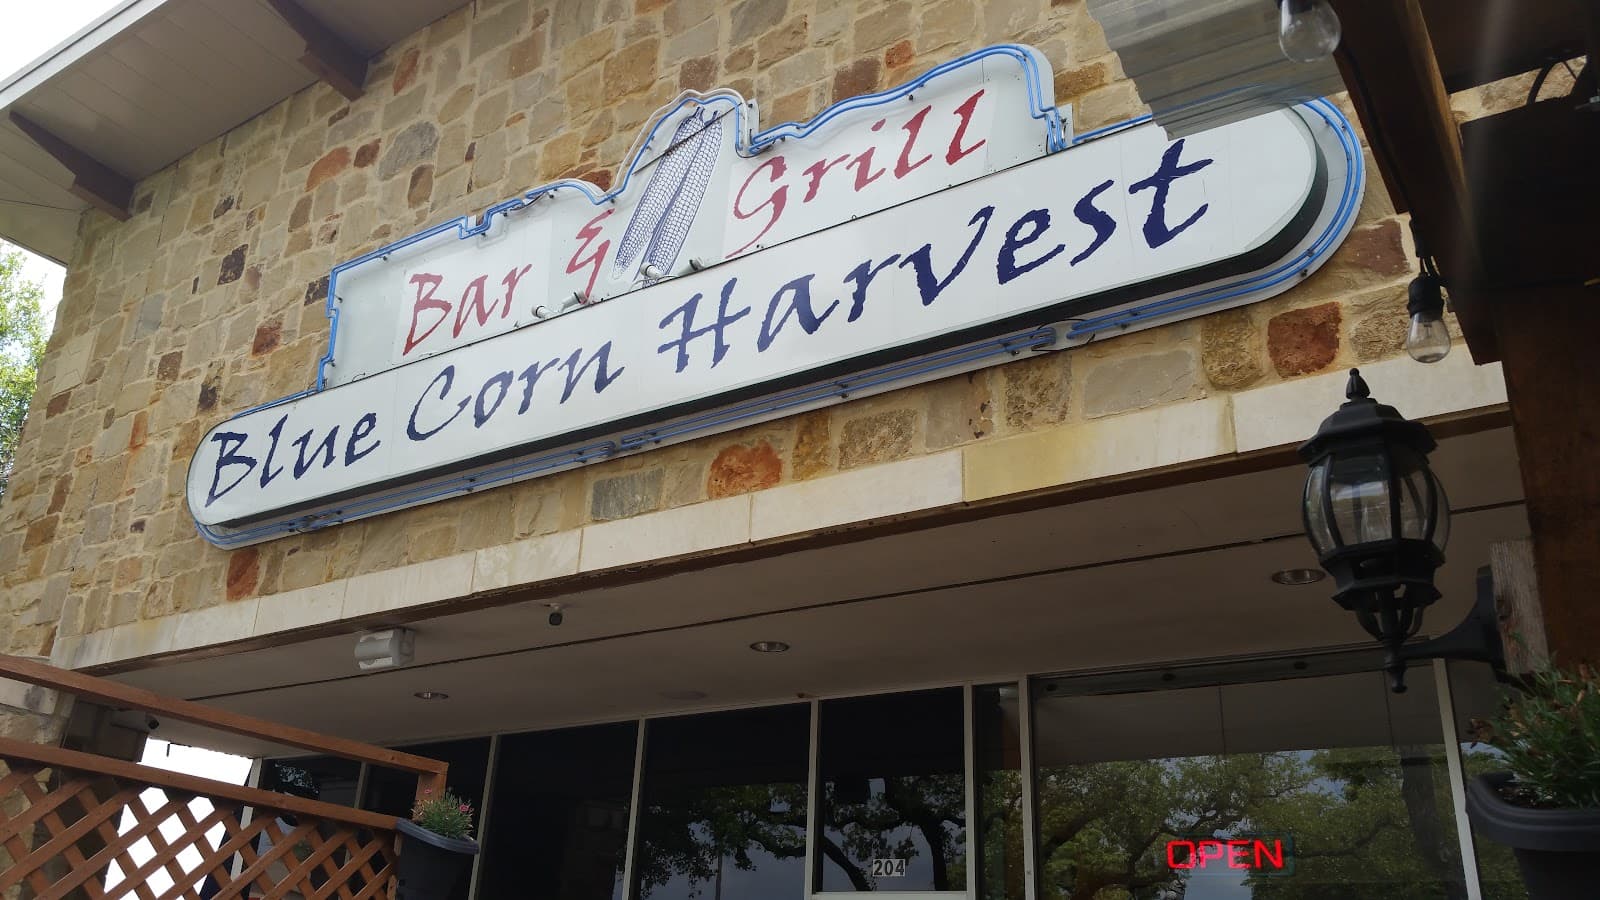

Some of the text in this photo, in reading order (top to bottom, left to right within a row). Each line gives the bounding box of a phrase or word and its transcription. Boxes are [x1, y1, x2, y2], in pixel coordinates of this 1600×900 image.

[403, 89, 986, 356] Bar & Grill
[205, 138, 1213, 508] Blue Corn Harvest
[873, 859, 905, 877] 204
[1166, 839, 1284, 870] OPEN
